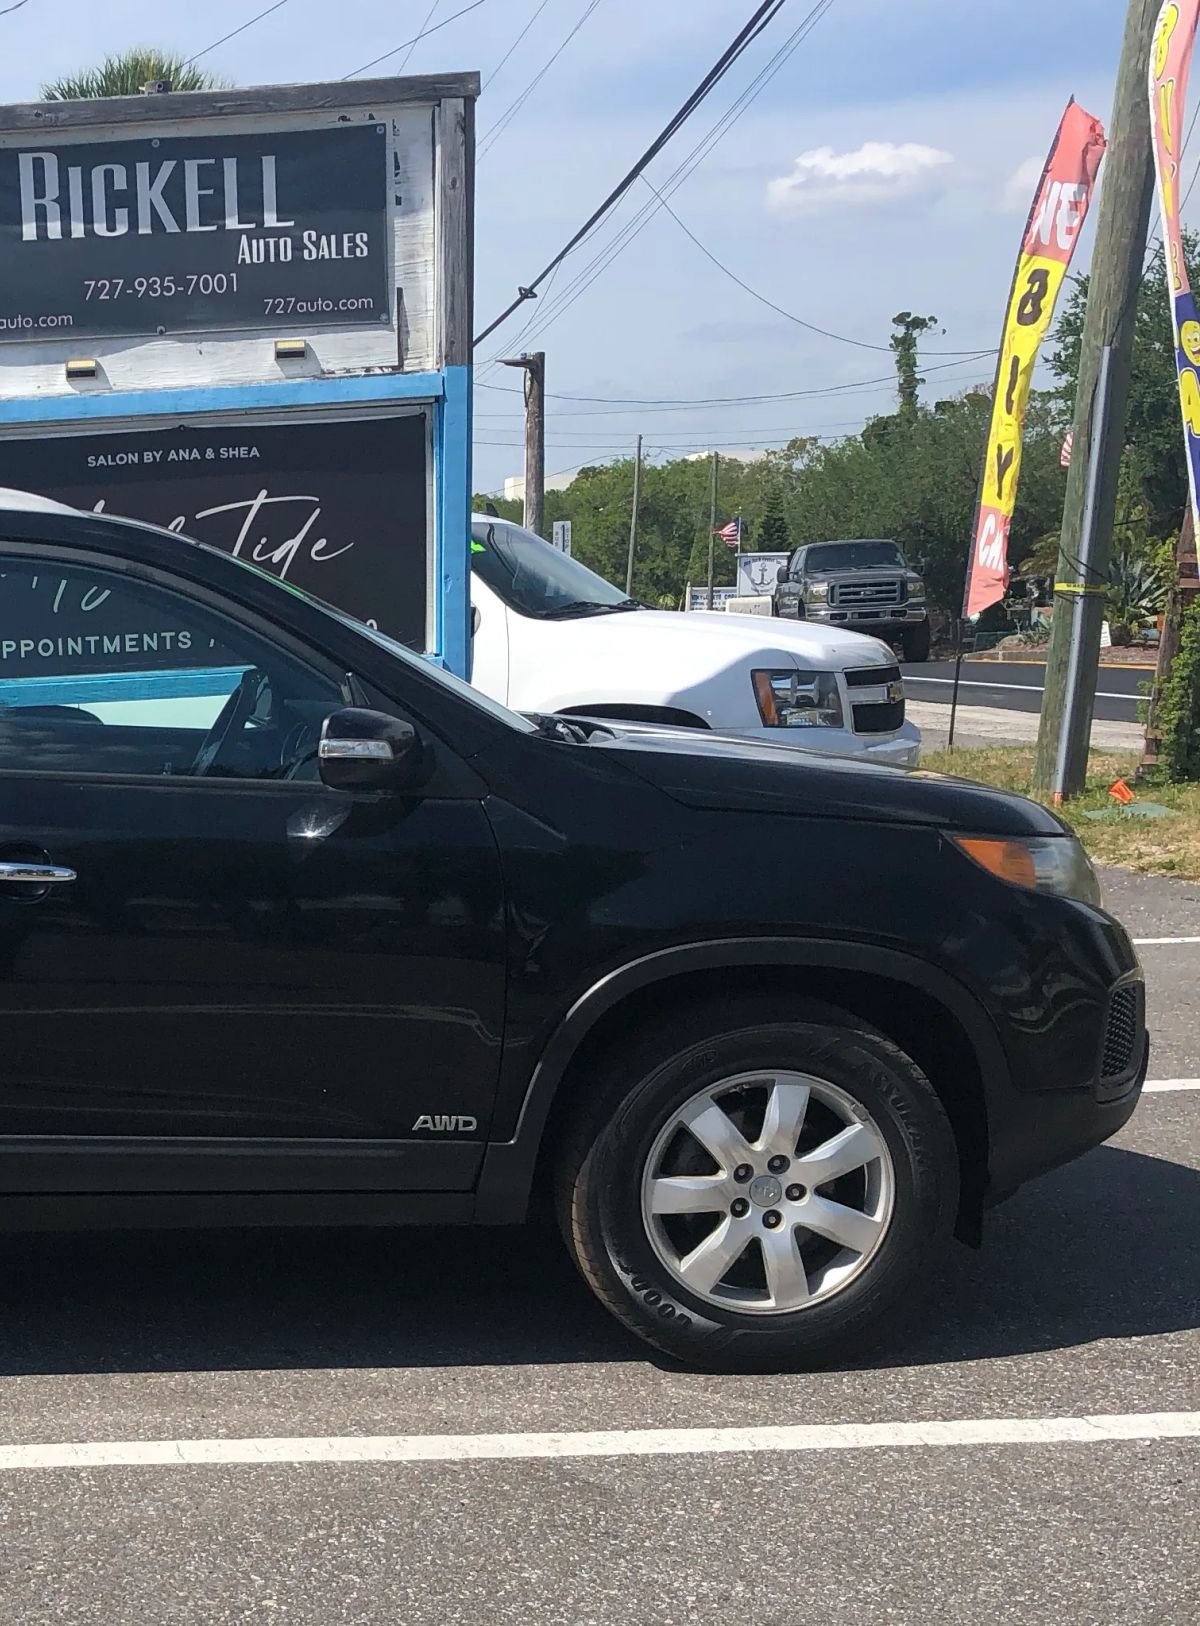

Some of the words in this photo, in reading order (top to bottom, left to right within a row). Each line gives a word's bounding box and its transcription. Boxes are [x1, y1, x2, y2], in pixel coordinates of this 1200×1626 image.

[237, 234, 292, 265] AUTO
[302, 230, 369, 261] SALES
[83, 272, 239, 301] 727-935-7001
[263, 295, 374, 315] 727auto.com
[87, 452, 139, 468] SALON
[143, 450, 163, 463] BY
[167, 448, 201, 462] ANA
[205, 447, 215, 460] &
[219, 446, 260, 460] SHEA
[195, 488, 354, 580] Tide
[411, 1115, 478, 1131] AWD
